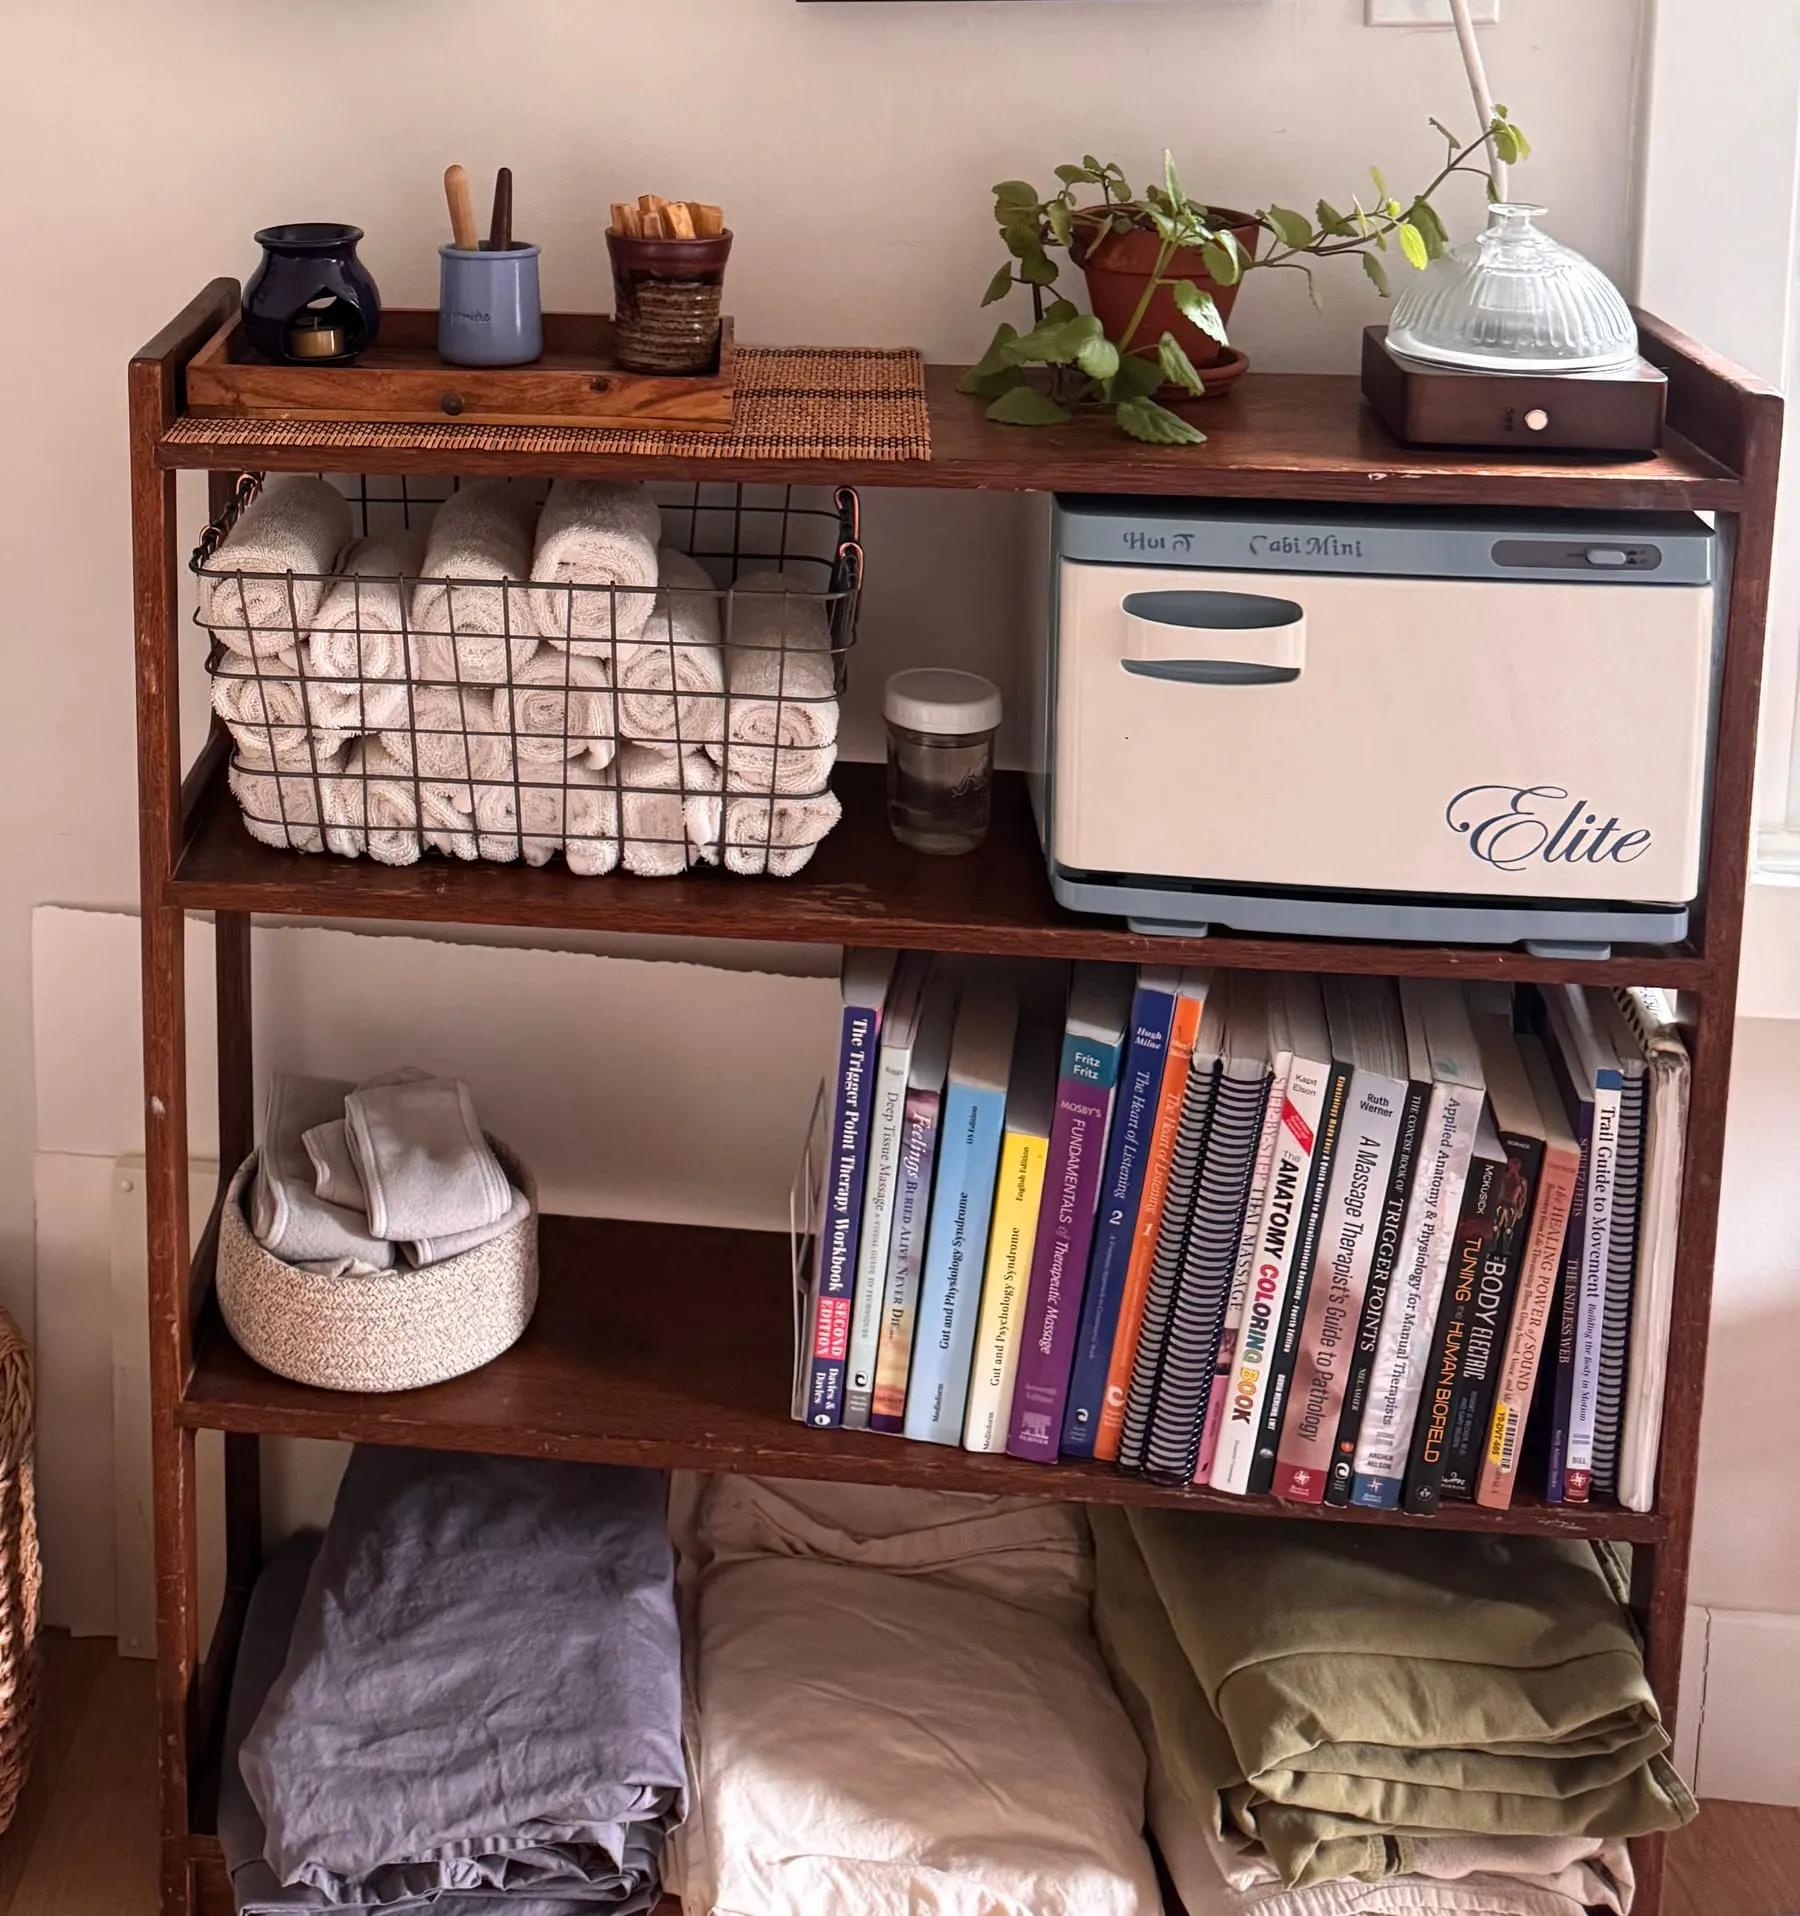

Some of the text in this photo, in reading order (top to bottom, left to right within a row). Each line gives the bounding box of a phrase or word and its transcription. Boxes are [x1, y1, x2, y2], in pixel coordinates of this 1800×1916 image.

[1304, 533, 1364, 558] Mini
[1446, 785, 1652, 872] Elite
[1074, 1052, 1101, 1068] Fritz
[1134, 1036, 1162, 1050] Milne
[1137, 1027, 1162, 1041] Hugh
[1073, 1065, 1099, 1081] Fritz
[1292, 1083, 1317, 1097] Elson
[1295, 1073, 1318, 1086] Kapit
[1367, 1093, 1390, 1108] Ruth
[1060, 1099, 1103, 1118] MOSBY'S
[1113, 1071, 1152, 1200] The Heart of Listening
[1359, 1100, 1394, 1118] Werner
[828, 1018, 868, 1292] The Trigger Point Therapy Workbook
[872, 1092, 899, 1212] Deep Tissue Massage
[904, 1111, 931, 1179] Feelings
[1143, 1093, 1181, 1216] The Heart of Listening
[1283, 1150, 1301, 1163] The
[902, 1180, 919, 1225] BURIED
[1108, 1209, 1124, 1225] 2
[1143, 1223, 1153, 1237] 1
[1262, 1158, 1300, 1261] ANATOMY
[1360, 1095, 1422, 1353] THE CONCISE BOOK OF TRIGGER POINTS
[899, 1227, 912, 1260] ALIVE
[1038, 1118, 1086, 1355] FUNDAMENTALS of Therapeutic Massage
[1382, 1098, 1462, 1427] Applied Anatomy & Physiology for Manual Therapists
[1542, 1205, 1566, 1273] HEALING
[1578, 1106, 1617, 1422] Trail Guide to Movement Building the Body in Motion
[894, 1267, 909, 1305] NEVER
[939, 1191, 969, 1350] Gut and Physiology Syndrome
[1229, 1234, 1256, 1312] MASSAGE
[1298, 1136, 1382, 1443] A Massage Therapist's Guide to Pathology
[1455, 1237, 1482, 1303] TUNING
[1474, 1261, 1507, 1327] BODY
[816, 1299, 834, 1356] EDITION
[831, 1301, 848, 1356] SECOND
[990, 1226, 1020, 1387] Gut and Psychology Syndrome
[1243, 1264, 1280, 1365] COLORING
[1528, 1274, 1552, 1327] POWER
[1559, 1259, 1579, 1364] THE ENDLESS WEB
[1439, 1320, 1465, 1387] HUMAN
[1462, 1326, 1495, 1381] ELECTRIC
[1516, 1342, 1536, 1392] SOUND
[814, 1372, 827, 1405] Davies
[825, 1368, 840, 1410] Davies &
[1231, 1367, 1260, 1425] BOOK
[1423, 1387, 1453, 1464] BIOFIELD
